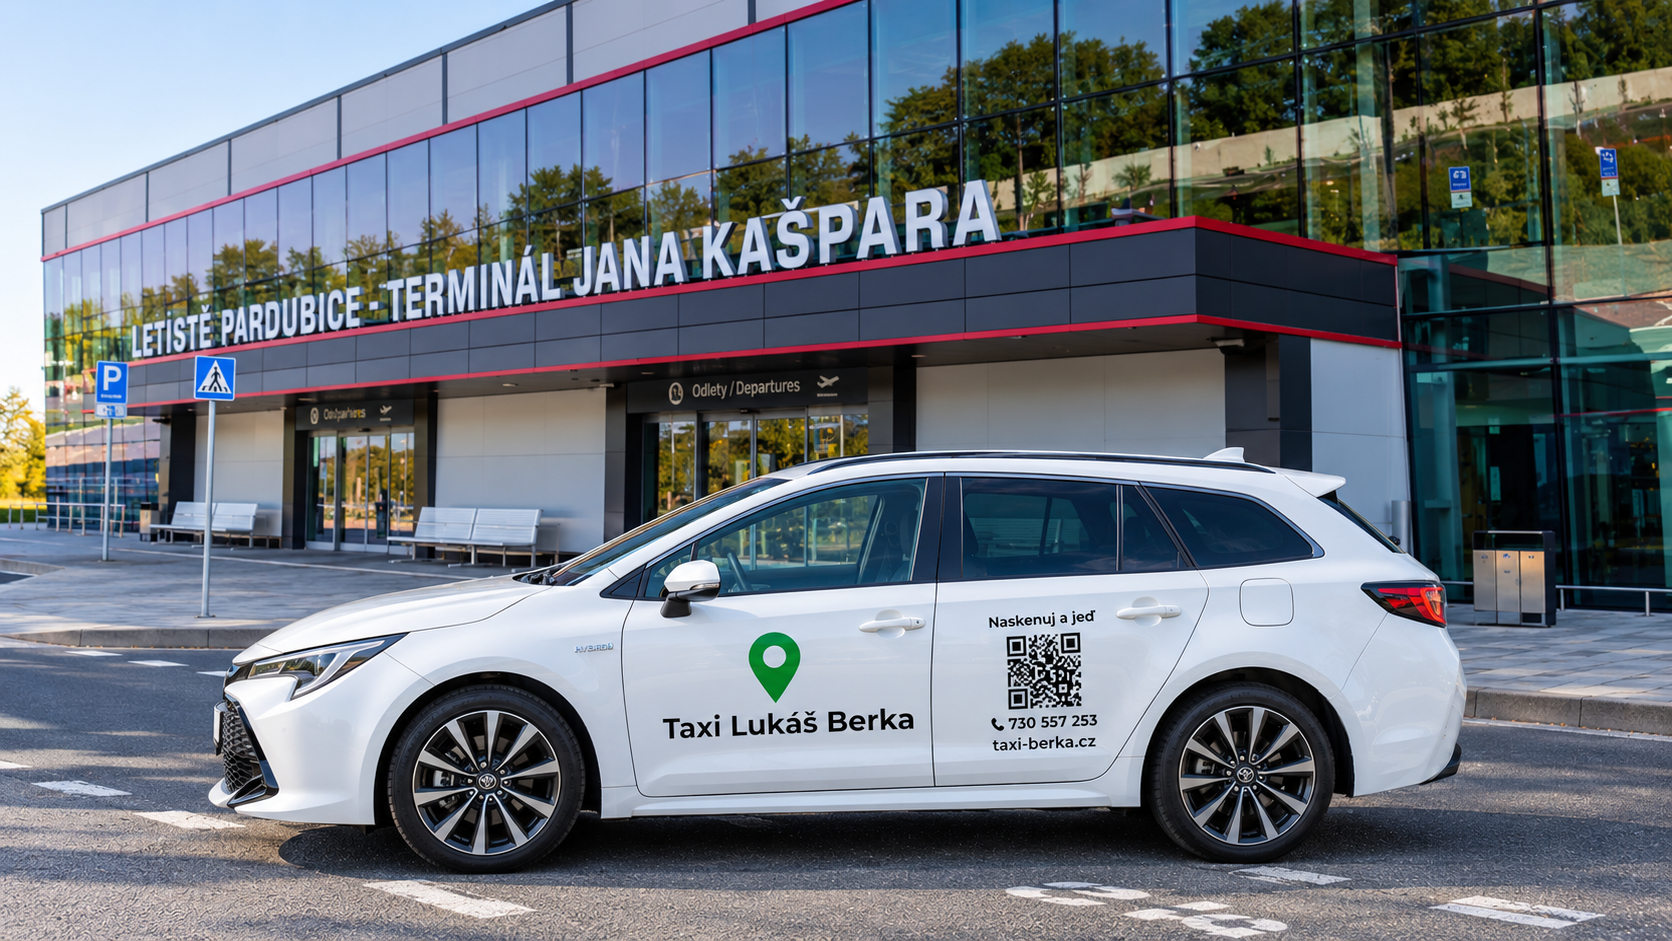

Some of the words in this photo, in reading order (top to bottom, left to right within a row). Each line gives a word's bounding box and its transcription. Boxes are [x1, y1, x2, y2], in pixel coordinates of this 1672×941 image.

[221, 286, 364, 346] PARDUBICE
[386, 245, 566, 322] TERMINÁL
[573, 231, 690, 297] JANA
[702, 179, 1002, 280] KAŠPARA
[103, 365, 122, 391] P
[692, 383, 728, 400] Odlety
[988, 612, 1056, 629] Naskenuj
[1060, 614, 1068, 624] a
[1071, 610, 1096, 626] jeď
[663, 714, 721, 740] Taxi
[731, 710, 818, 737] Lukáš
[827, 708, 915, 733] Berka
[1008, 716, 1036, 730] 730
[1041, 715, 1067, 728] 557
[1071, 714, 1098, 727] 253
[992, 735, 1096, 751] taxi-berka.cz
